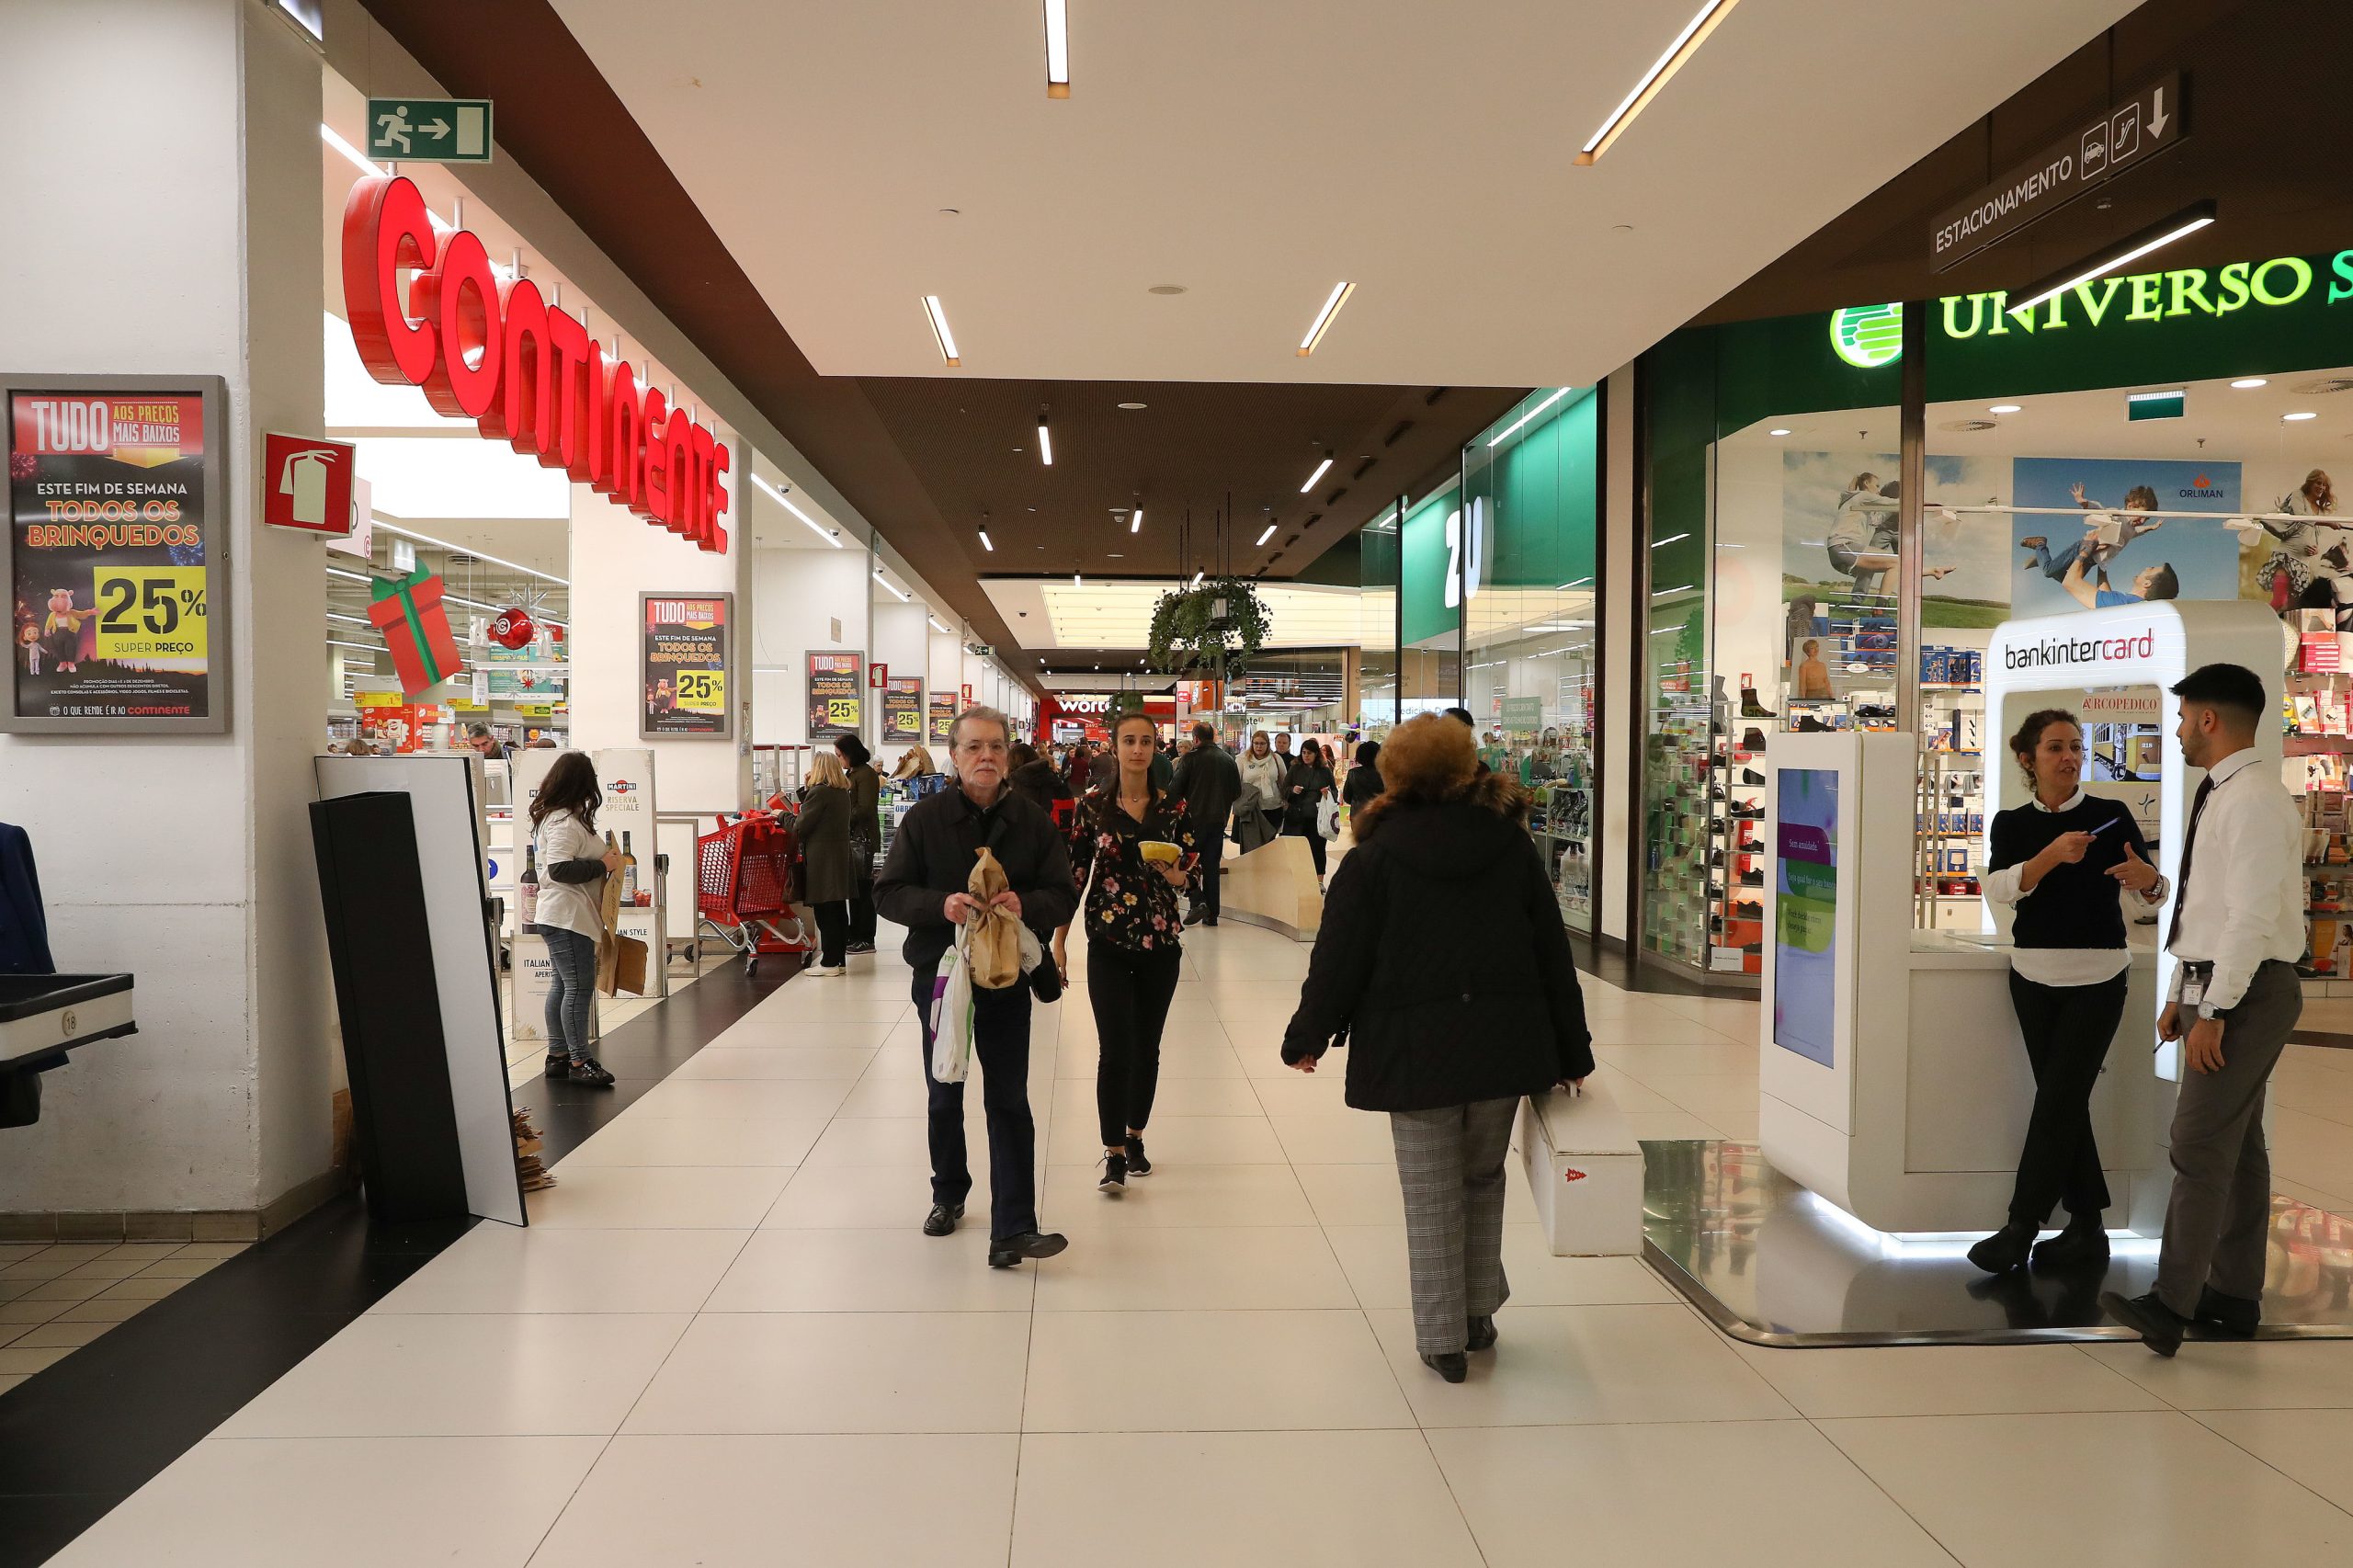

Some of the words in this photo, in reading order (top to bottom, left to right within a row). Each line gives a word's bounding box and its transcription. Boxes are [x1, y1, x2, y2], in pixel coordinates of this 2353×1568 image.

[1935, 155, 2073, 254] ESTACIONAMENTO
[1939, 256, 2313, 339] UNIVERSO
[113, 404, 134, 421] AOS
[138, 405, 179, 425] PREÇOS
[30, 401, 108, 451] TUDO
[113, 422, 139, 443] MAIS
[142, 423, 180, 444] BAIXOS
[37, 483, 72, 495] ESTE
[75, 483, 100, 495] FIM
[104, 483, 124, 495] DE
[127, 483, 188, 495] SEMANA
[2179, 489, 2223, 498] ORLIMAN
[46, 499, 138, 522] TODOS
[143, 499, 180, 522] OS
[28, 524, 199, 551] BRINQUEDOS
[100, 577, 207, 635] 25%
[654, 602, 686, 623] TUDO
[114, 642, 152, 653] SUPER
[155, 642, 194, 655] PREÇO
[658, 642, 696, 653] TODOS
[698, 642, 713, 653] OS
[2006, 628, 2154, 670] bankintercard
[650, 652, 721, 664] BRINQUEDOS
[814, 656, 834, 670] TUDO
[678, 675, 722, 699] 25%
[63, 706, 68, 715] O
[70, 705, 82, 715] QUE
[85, 705, 103, 715] RENDE
[106, 703, 109, 715] É
[111, 706, 117, 715] IR
[118, 705, 126, 715] AO
[606, 803, 640, 812] SPECIALE
[608, 795, 638, 804] RISERVA
[524, 959, 551, 968] ITALIAN
[66, 1016, 76, 1030] 18
